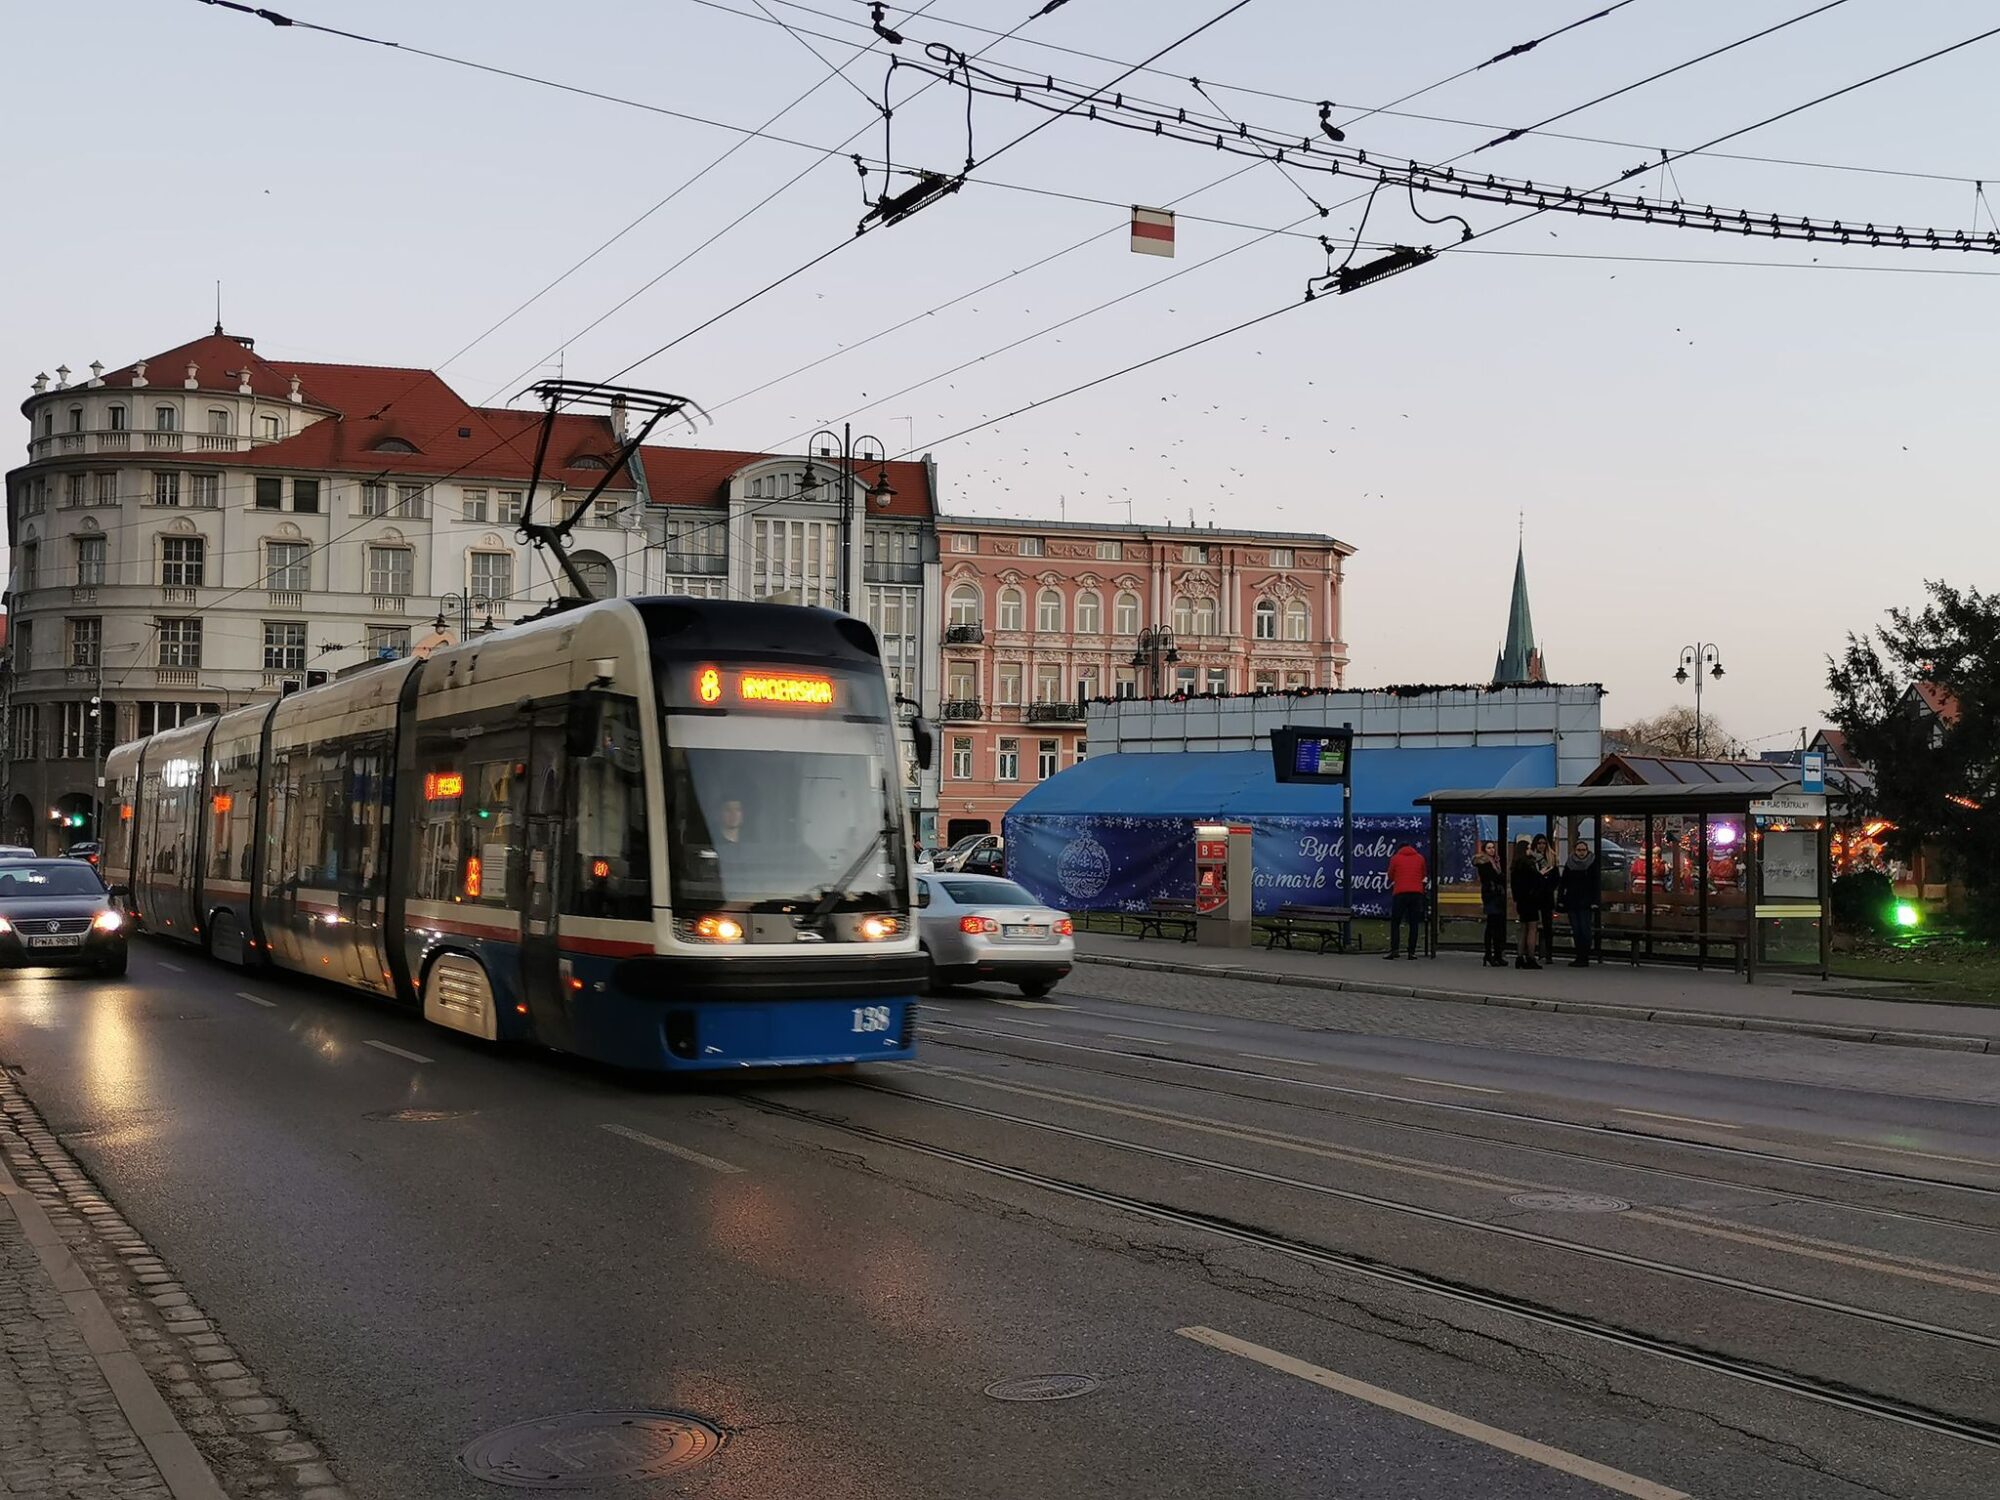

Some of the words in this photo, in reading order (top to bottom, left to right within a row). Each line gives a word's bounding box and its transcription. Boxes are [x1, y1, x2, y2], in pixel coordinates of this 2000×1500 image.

[701, 668, 721, 702] 8
[1201, 844, 1209, 856] B
[1299, 835, 1397, 862] Bydoski
[850, 1005, 891, 1033] 138
